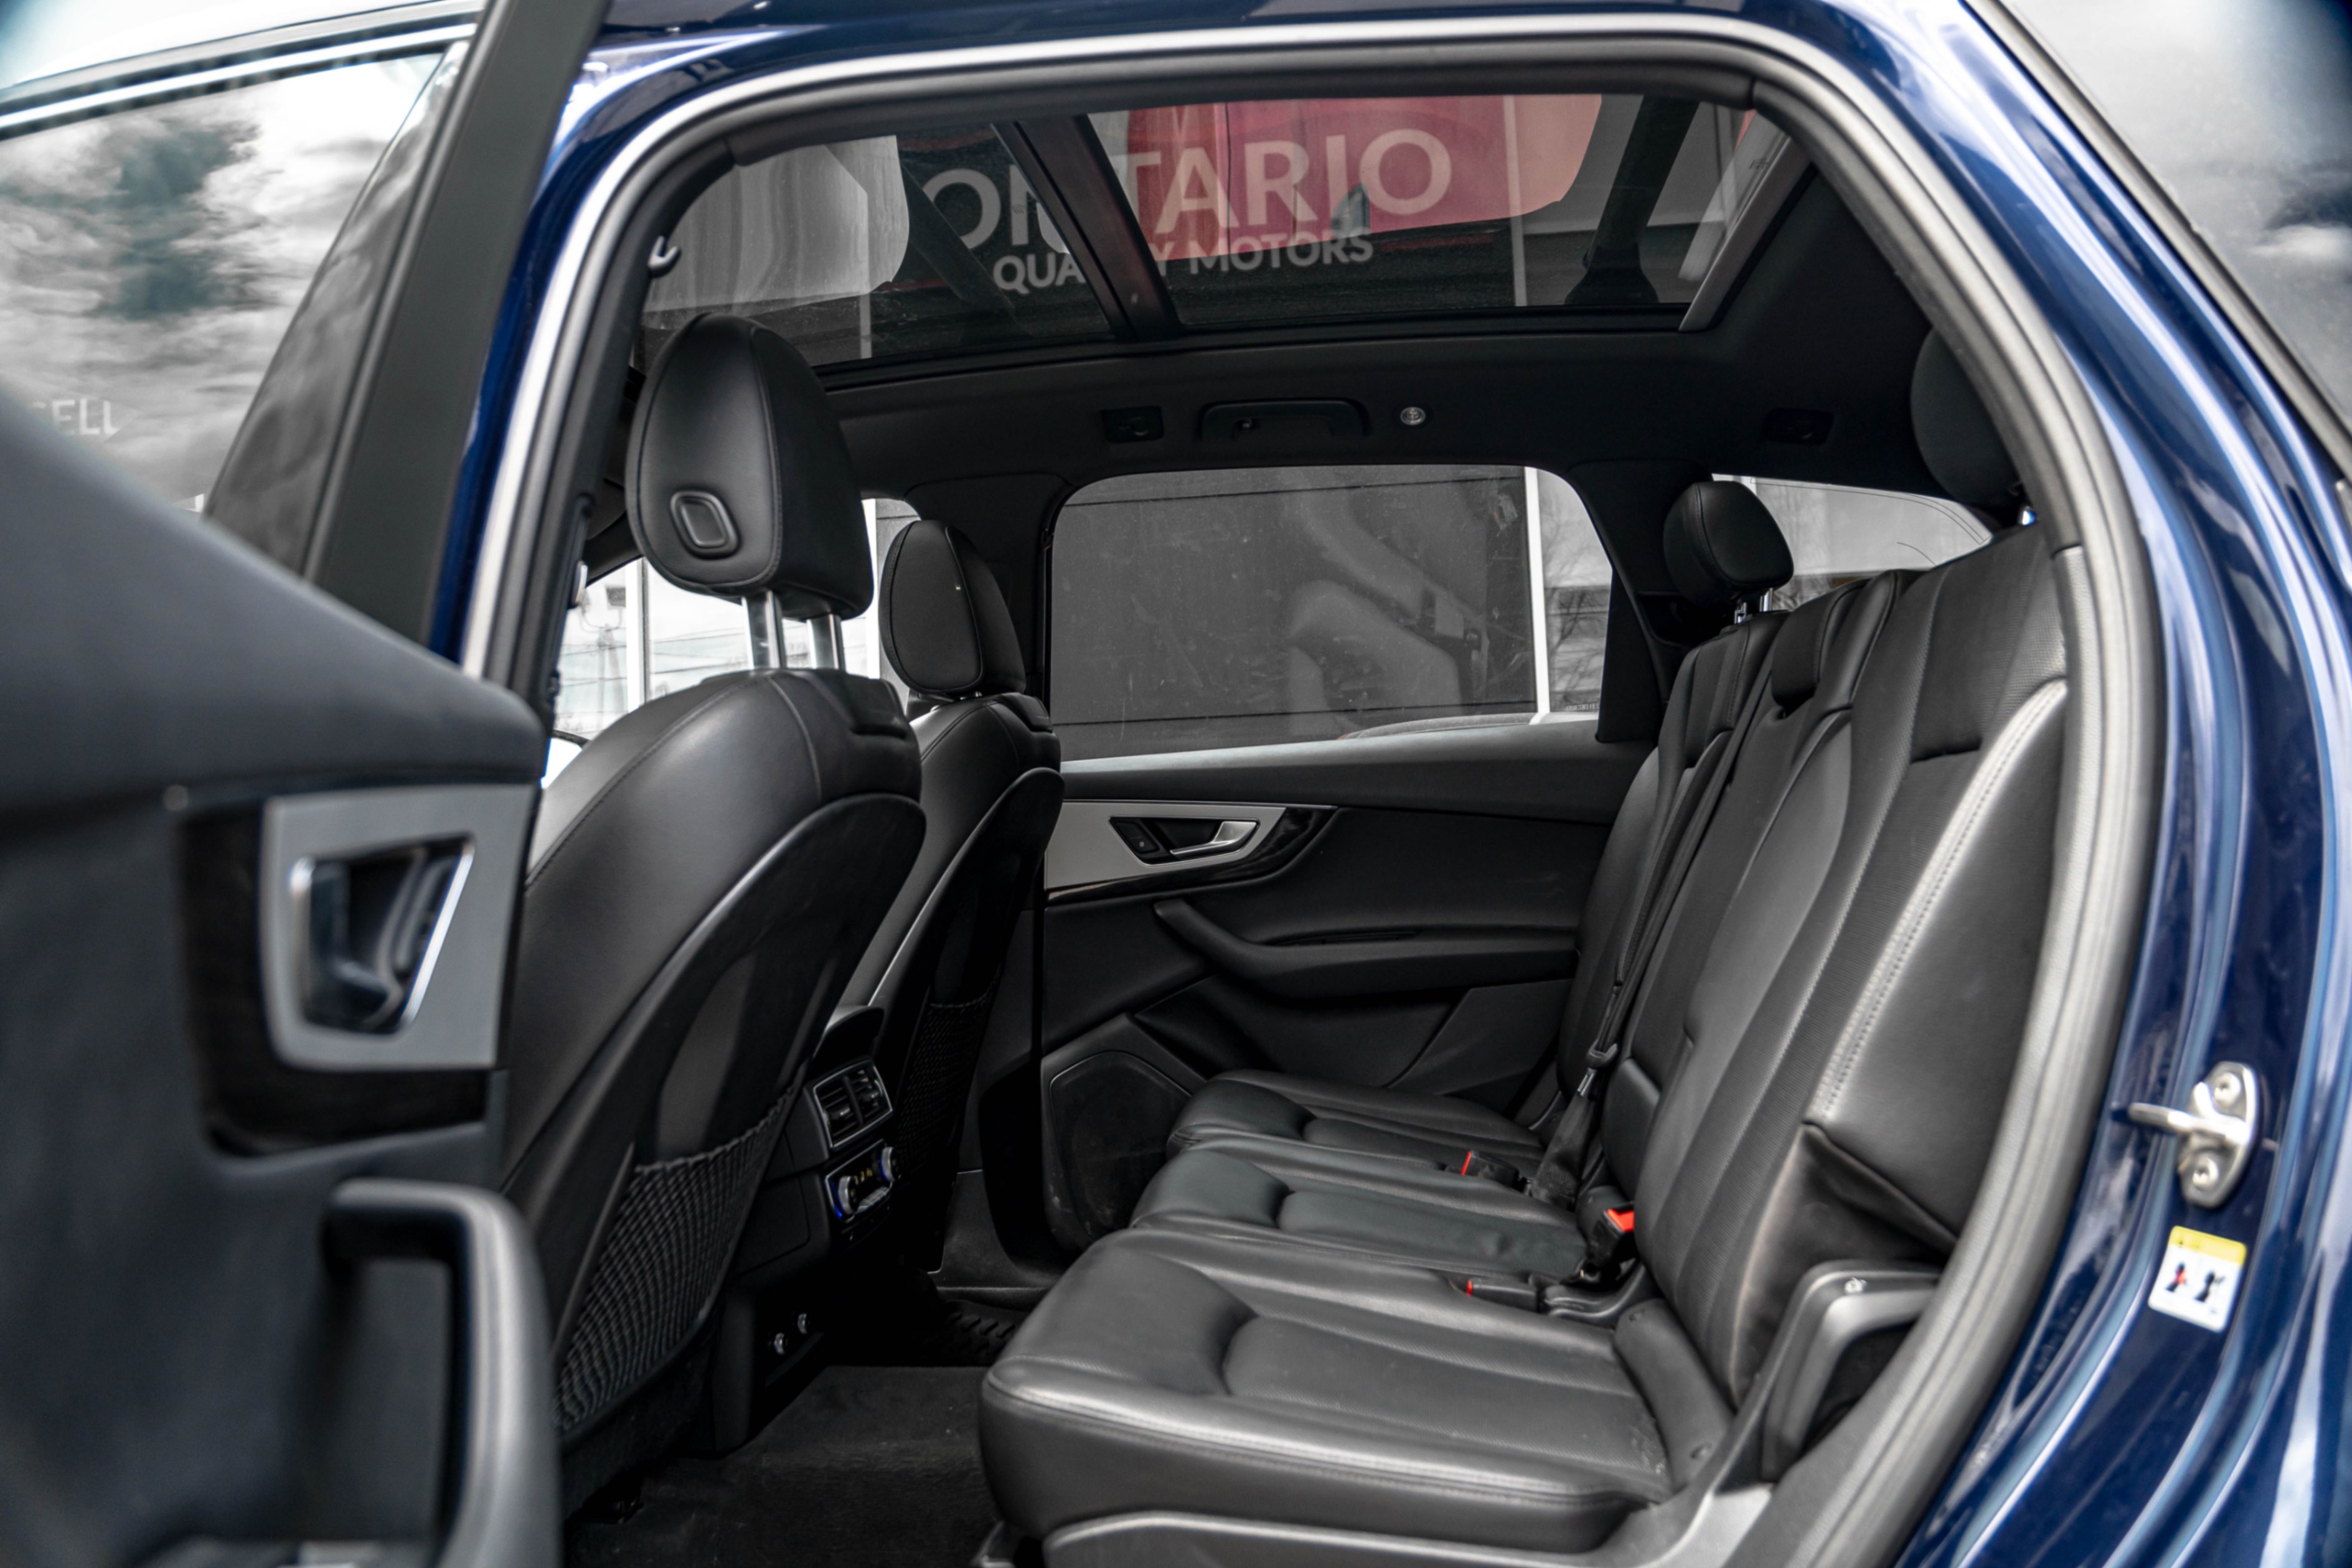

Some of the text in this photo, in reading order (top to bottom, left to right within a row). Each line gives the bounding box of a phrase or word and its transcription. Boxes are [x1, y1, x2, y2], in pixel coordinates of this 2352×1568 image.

[993, 226, 1374, 295] QUAY MOTORS
[32, 398, 120, 435] ELL
